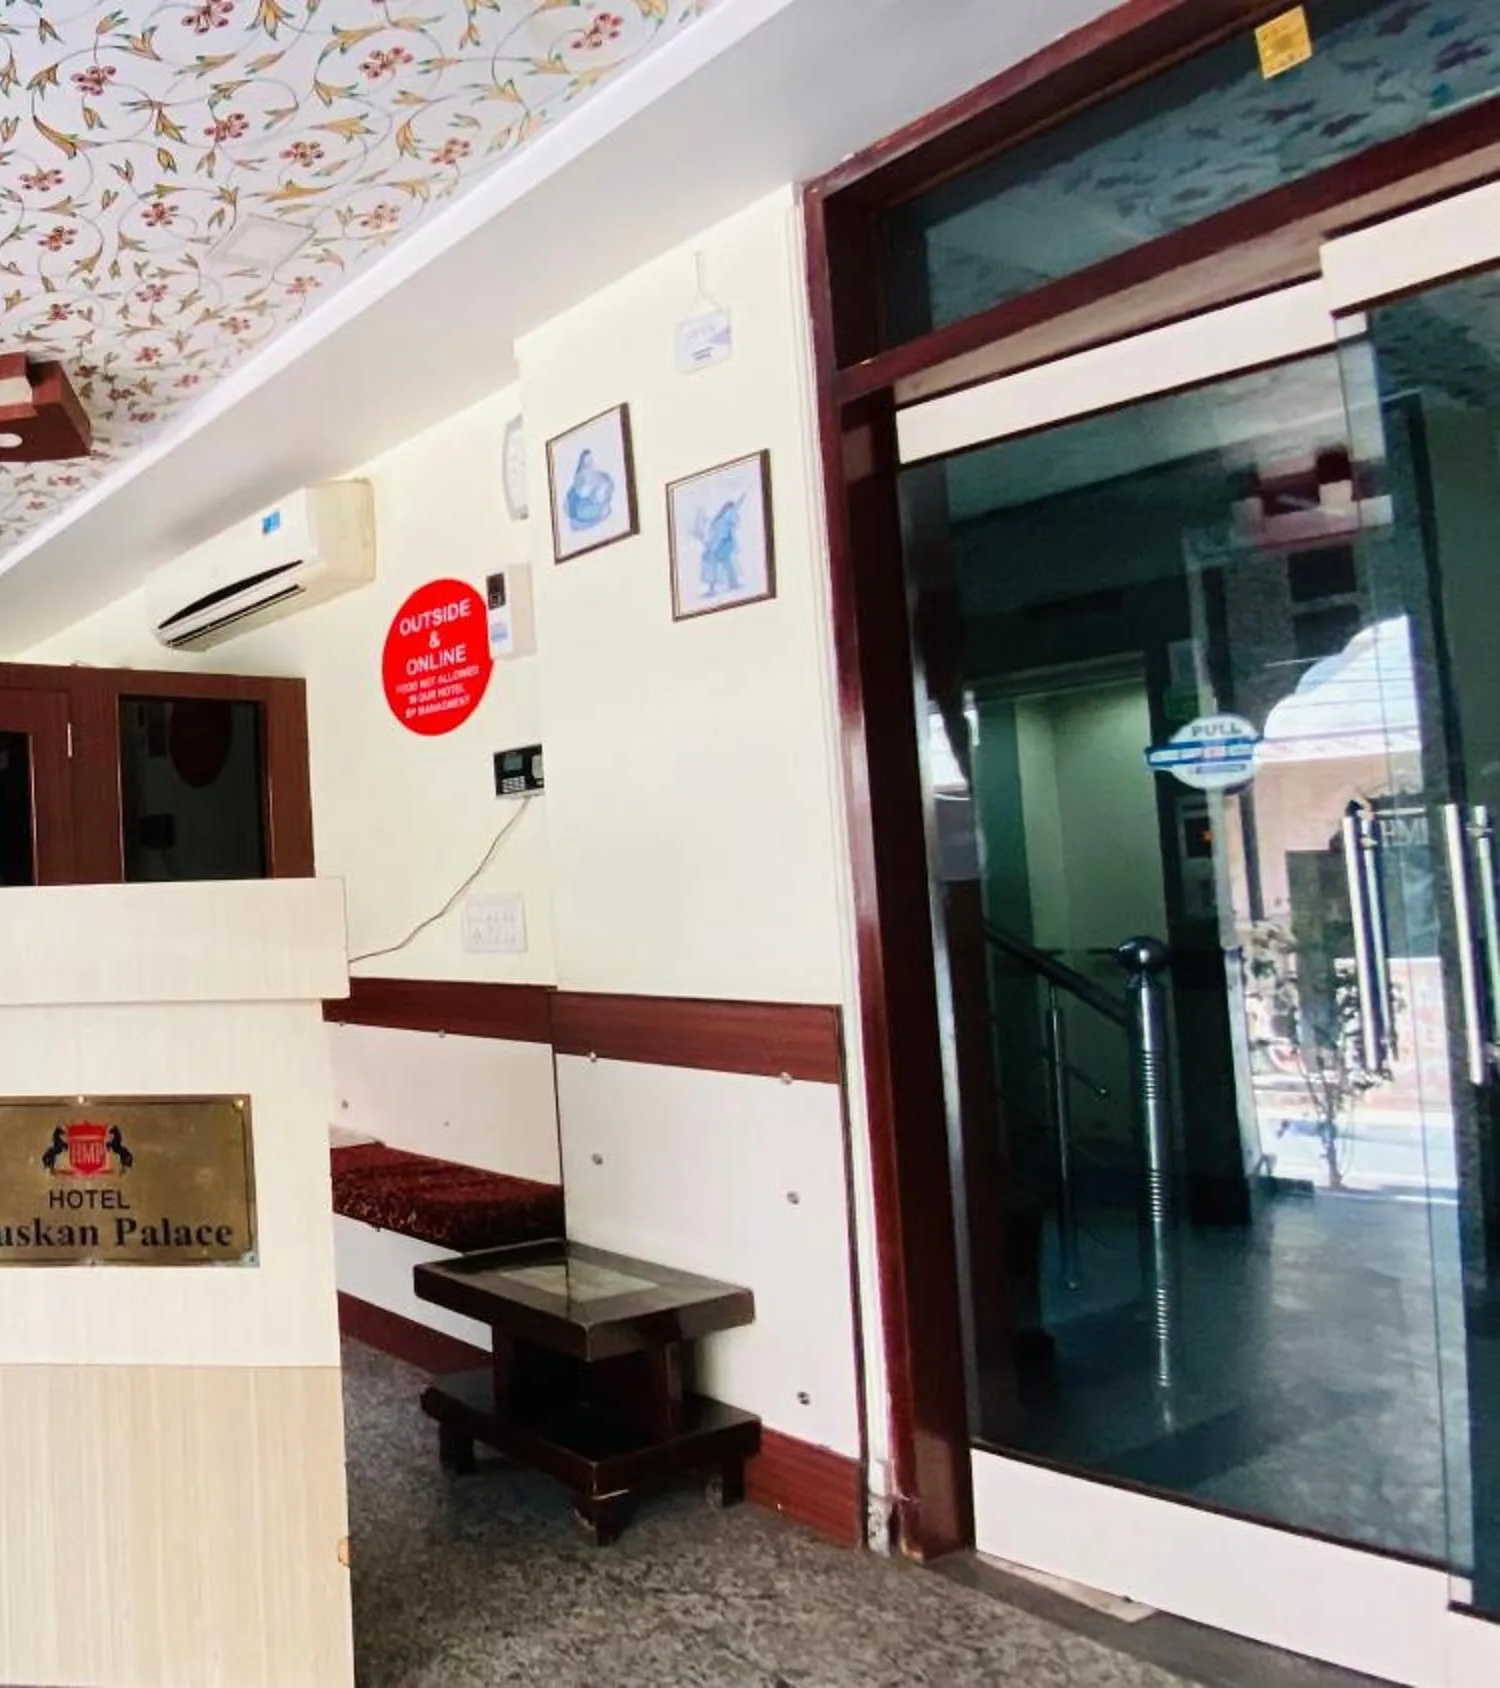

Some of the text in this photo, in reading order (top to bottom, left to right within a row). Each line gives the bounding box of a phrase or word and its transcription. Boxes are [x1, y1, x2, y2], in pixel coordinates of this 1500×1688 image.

[400, 599, 470, 635] OUTSIDE
[429, 630, 440, 648] &
[406, 644, 467, 675] ONLINE
[1192, 723, 1242, 737] PULL
[71, 1141, 104, 1164] HMP
[49, 1190, 131, 1209] HOTEL
[115, 1218, 234, 1247] Palace
